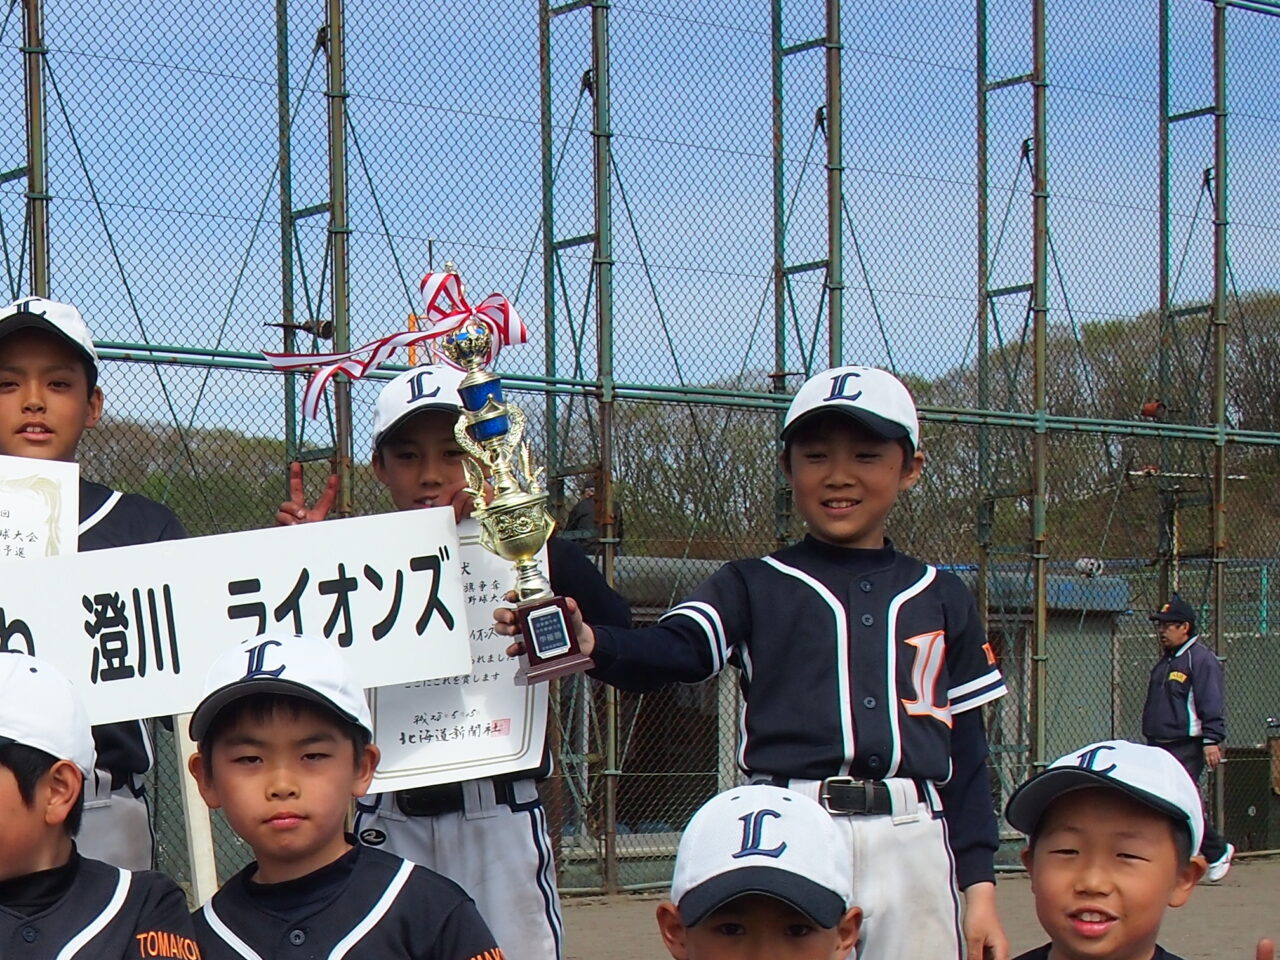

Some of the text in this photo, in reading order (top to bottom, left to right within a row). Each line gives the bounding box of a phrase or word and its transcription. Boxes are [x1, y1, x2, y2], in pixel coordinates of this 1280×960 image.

[406, 371, 441, 404] L
[822, 371, 862, 402] L
[82, 583, 180, 686] 澄川
[227, 545, 455, 647] ライオンズ
[240, 640, 286, 680] L
[731, 808, 788, 859] L
